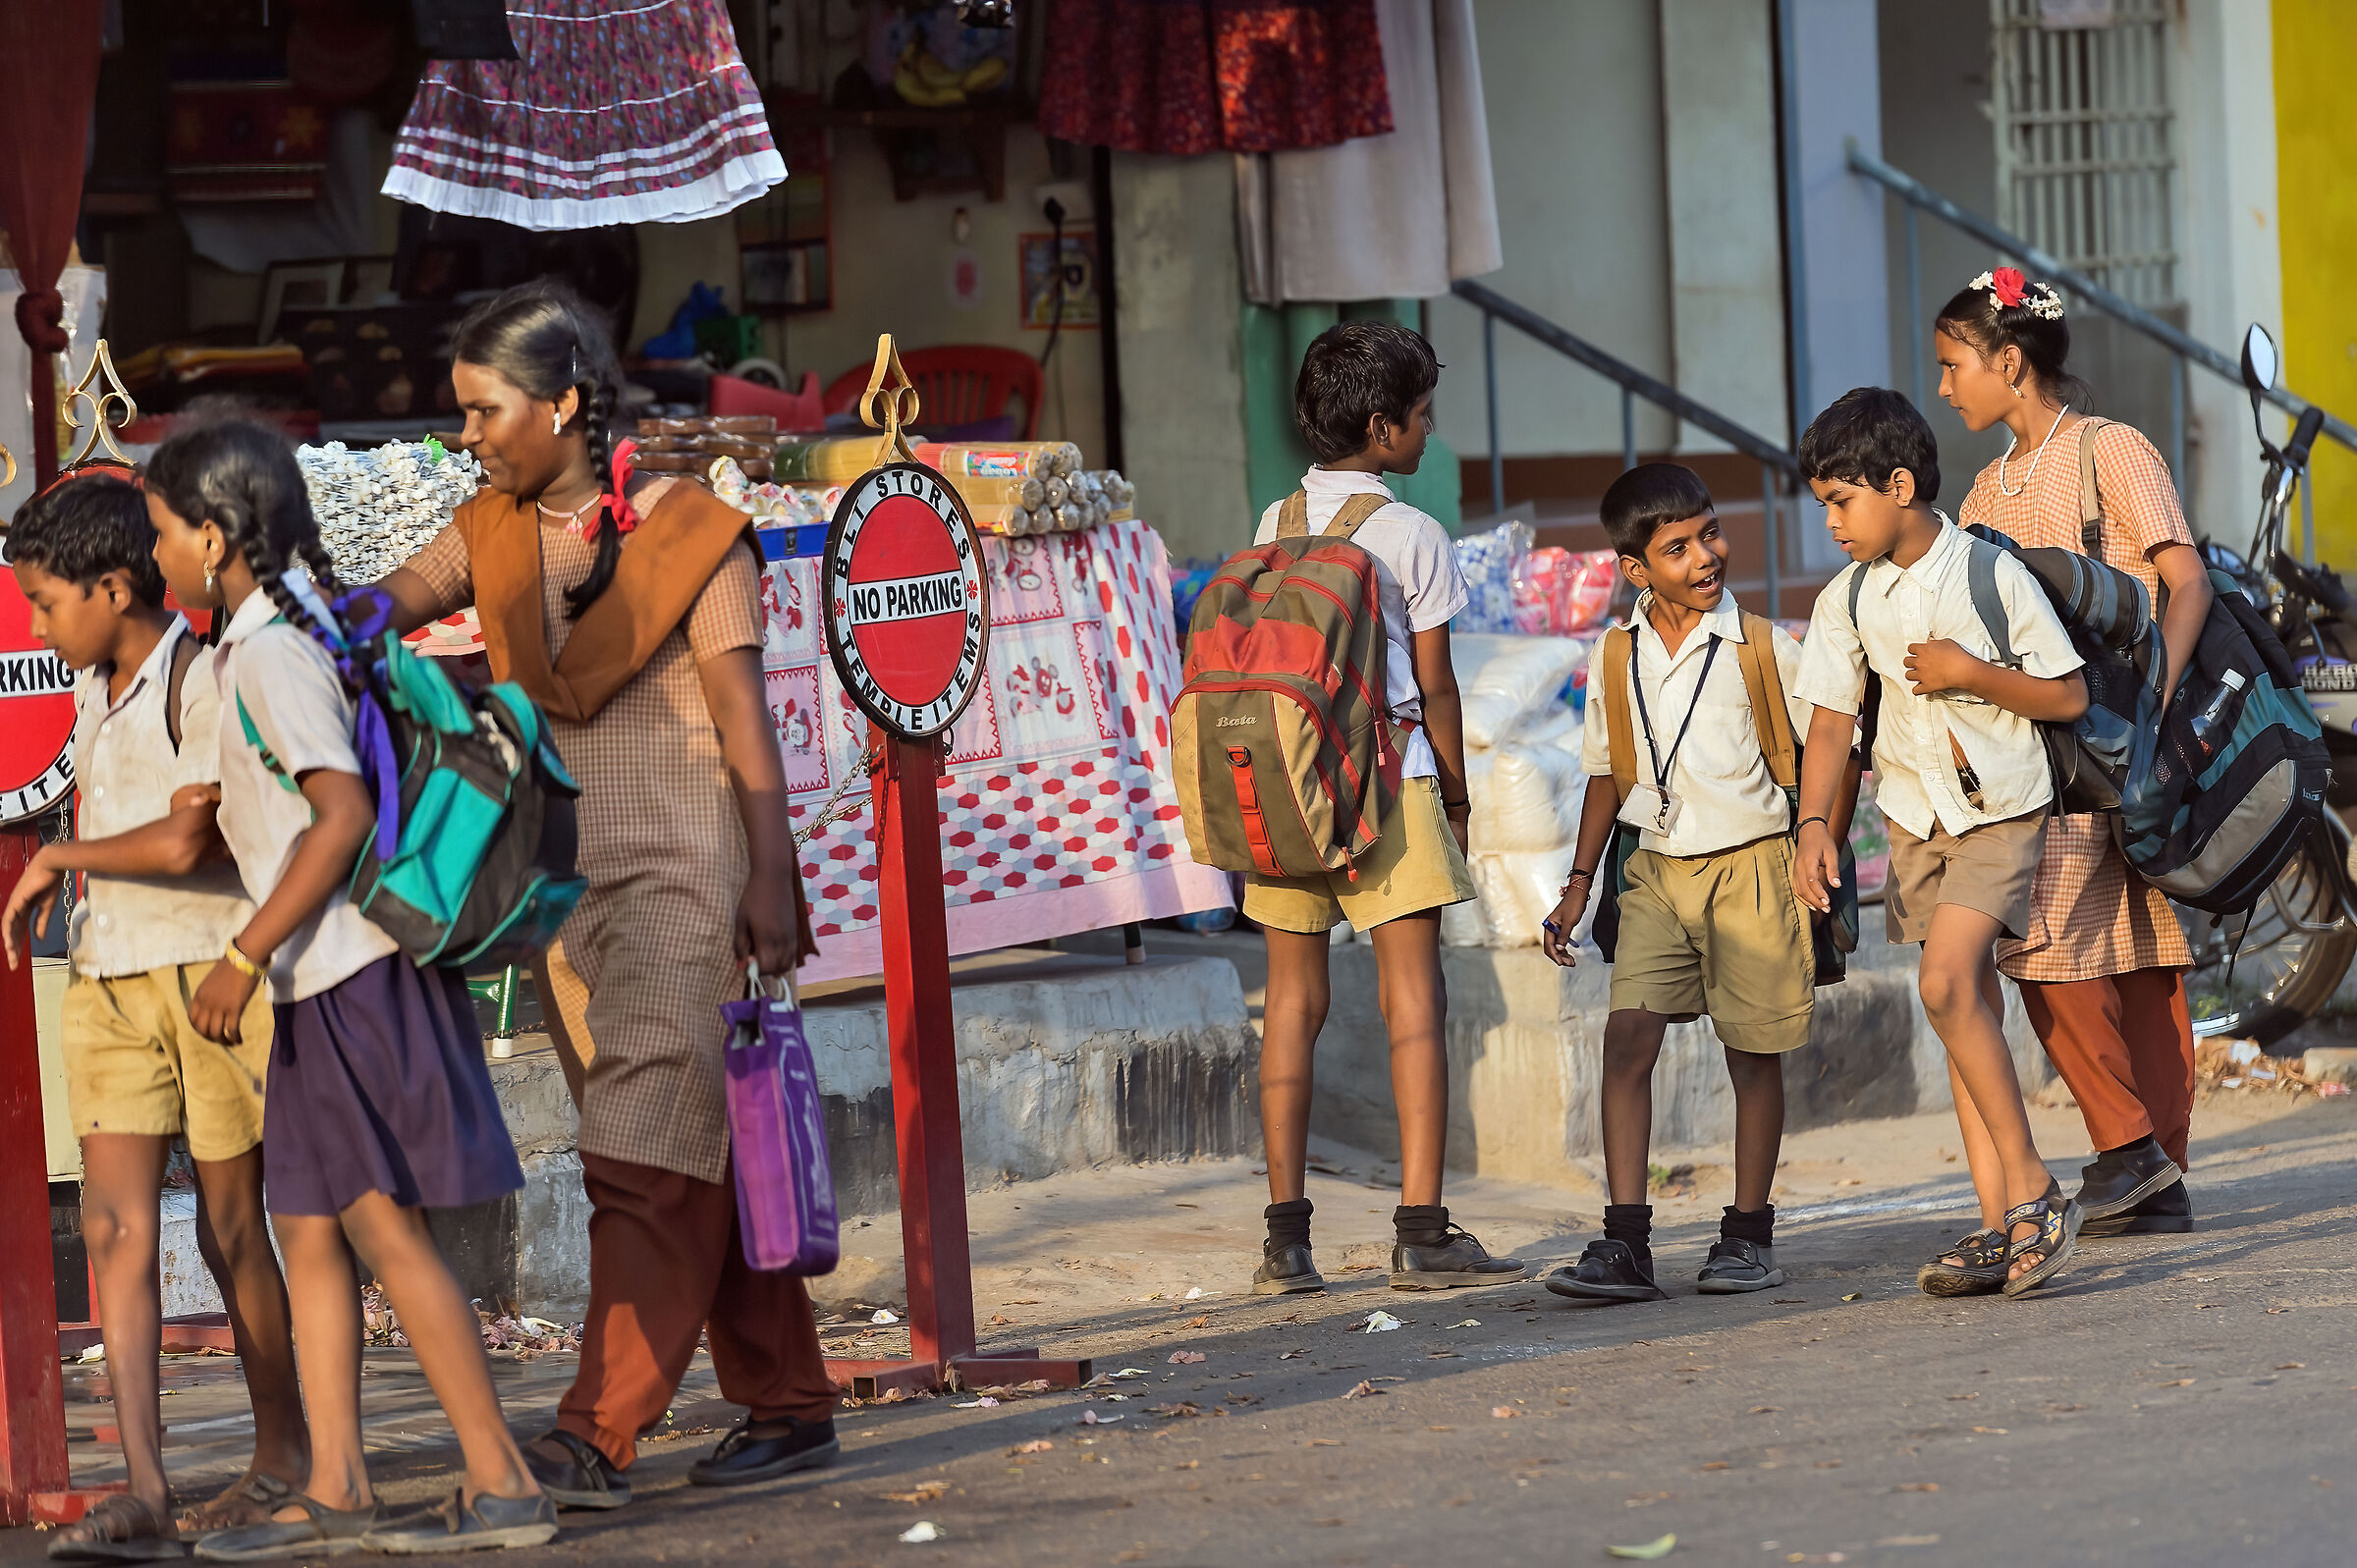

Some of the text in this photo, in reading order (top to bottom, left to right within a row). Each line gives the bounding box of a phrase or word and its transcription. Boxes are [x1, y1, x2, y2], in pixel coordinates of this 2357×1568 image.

[876, 471, 970, 560] STORES
[852, 576, 962, 621] NO PARKING
[842, 612, 981, 730] TEMPLE ITEMS
[1216, 715, 1257, 728] Bata
[19, 733, 75, 813] ITE
